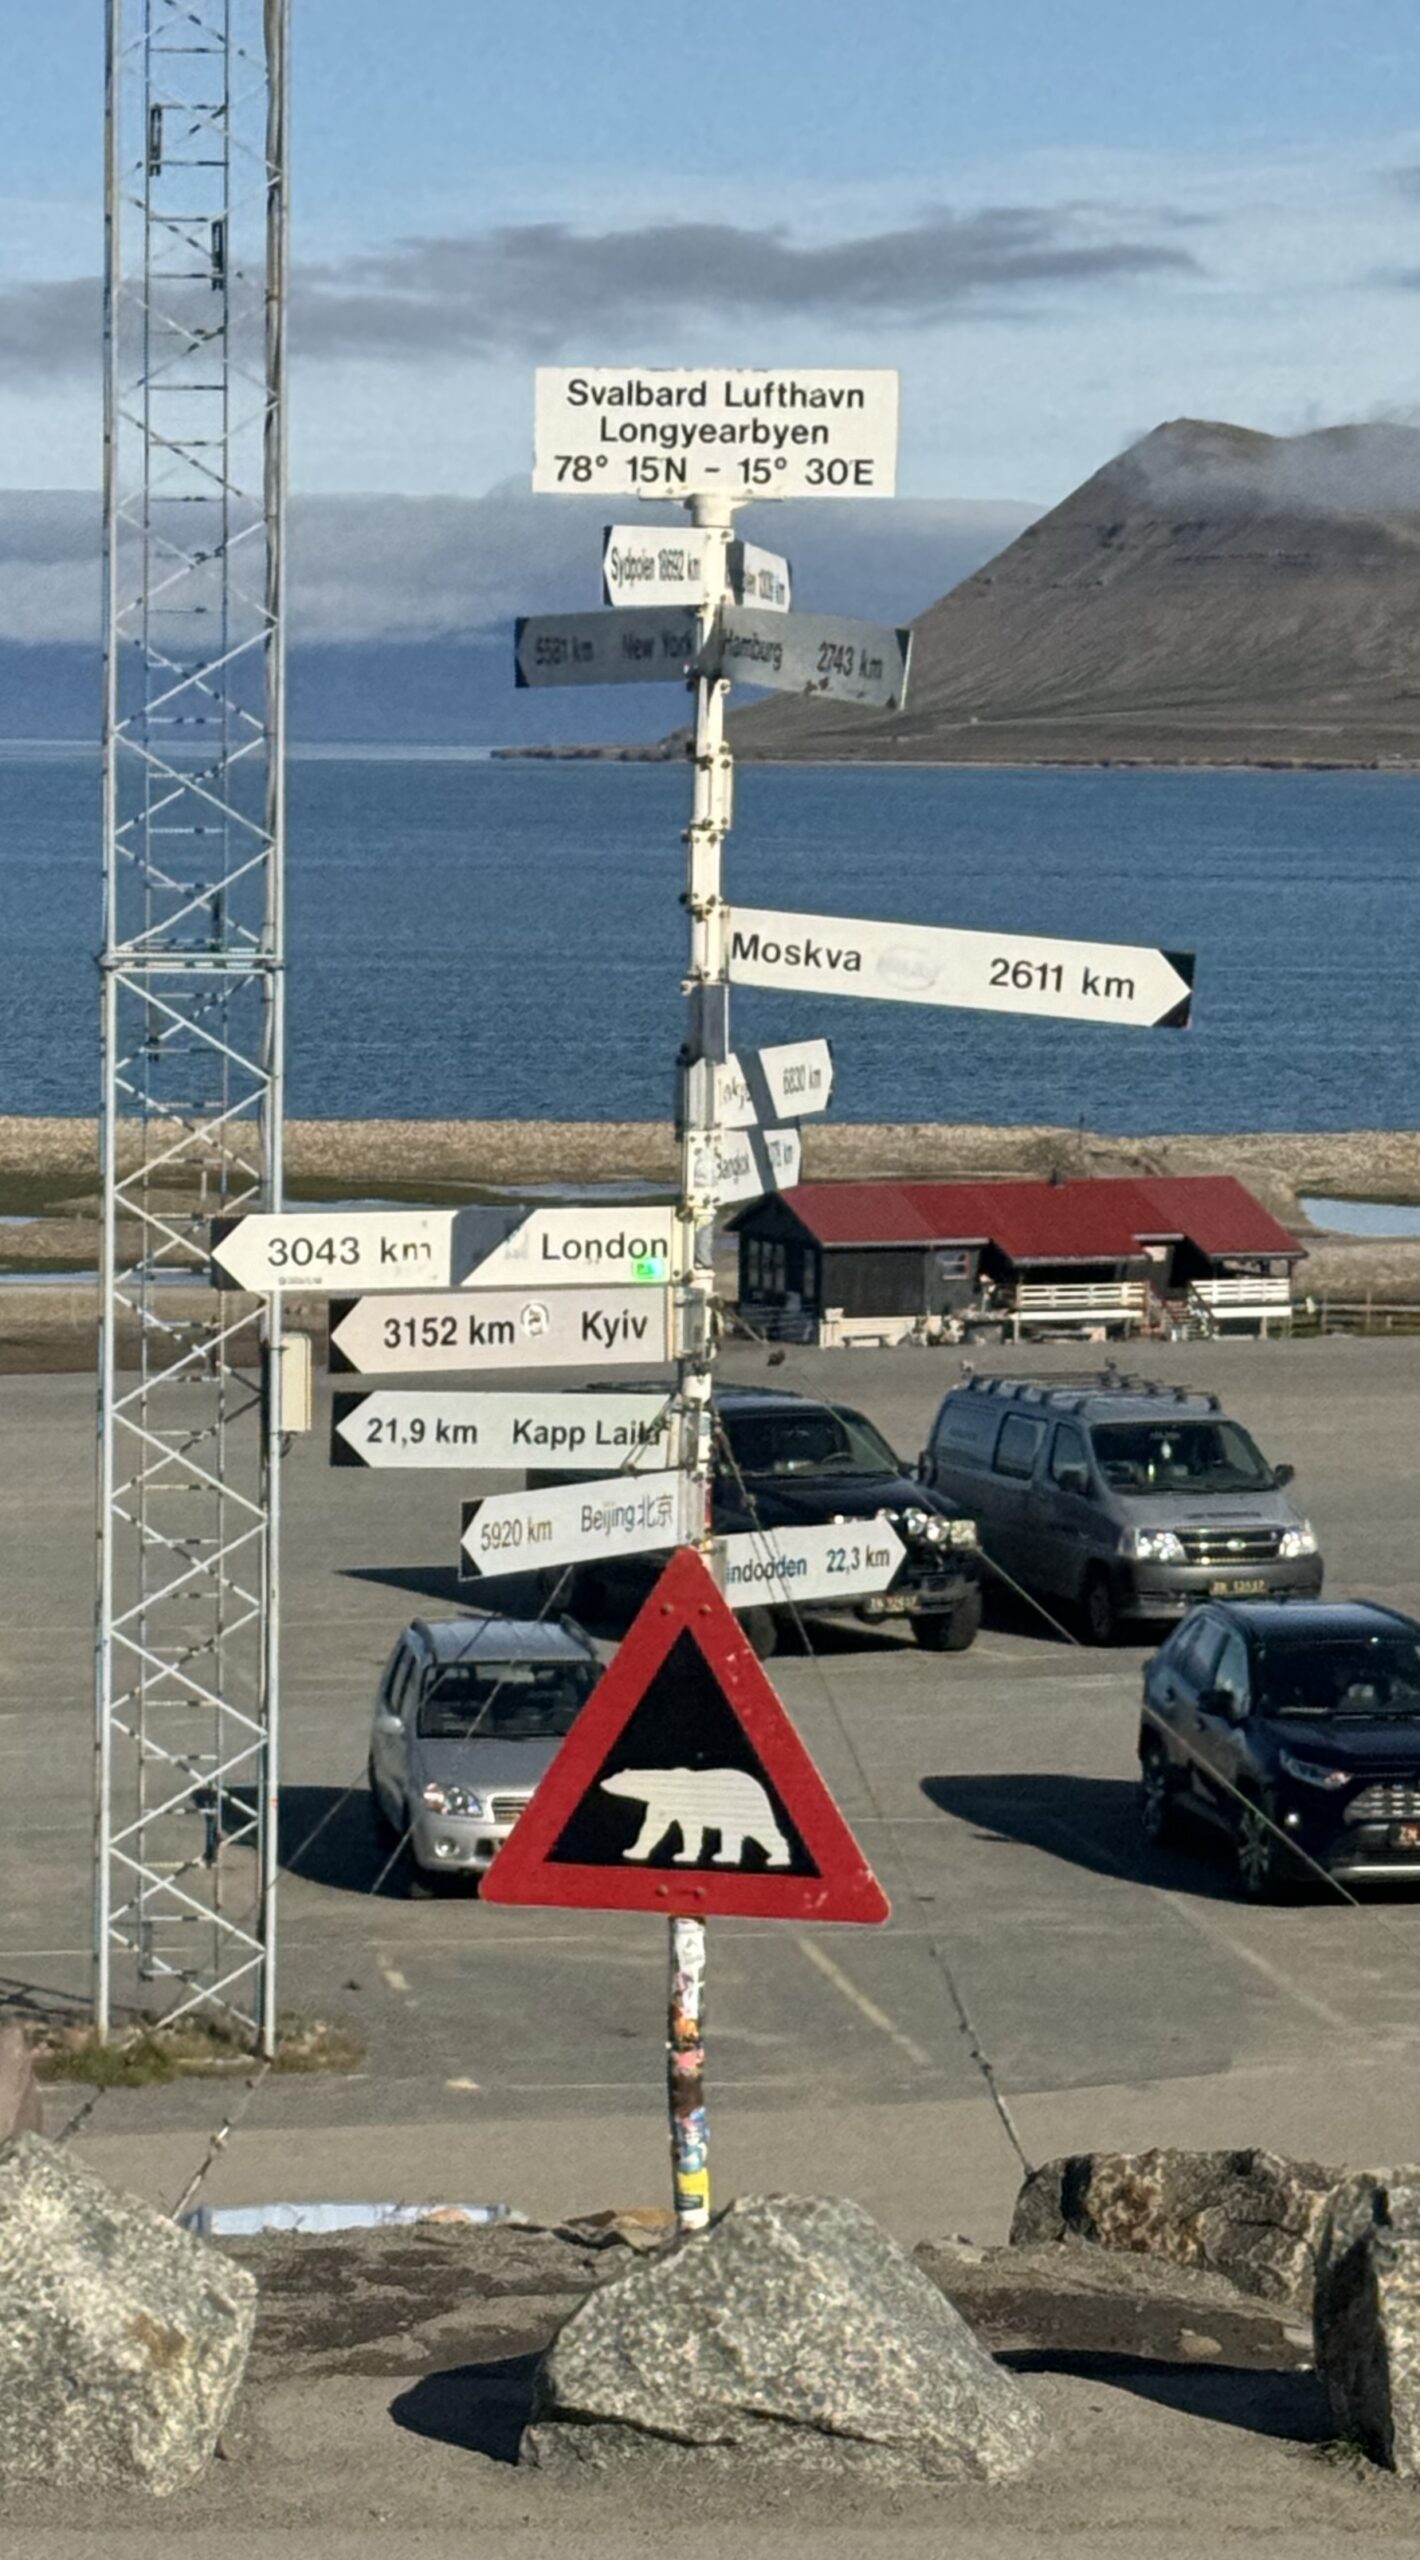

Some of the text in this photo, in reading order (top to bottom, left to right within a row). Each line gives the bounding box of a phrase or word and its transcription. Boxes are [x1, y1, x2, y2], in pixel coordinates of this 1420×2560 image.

[566, 378, 864, 408] Svalbard Lufthavn
[600, 415, 829, 450] Longyearbyen
[553, 454, 608, 483] 78°
[737, 456, 787, 485] 15°
[611, 546, 655, 588] Sydpolen
[687, 553, 701, 581] km
[572, 636, 593, 662] km
[622, 632, 655, 661] New
[661, 629, 693, 658] York
[724, 628, 883, 680] Hamburg 2743 km
[731, 931, 862, 972] Moskva
[989, 957, 1063, 993] 2611
[1081, 966, 1135, 1000] km
[809, 1064, 822, 1089] km
[267, 1236, 361, 1267] 3043
[380, 1236, 432, 1264] km
[541, 1231, 668, 1261] London
[384, 1315, 458, 1349] 3152
[469, 1314, 515, 1346] km
[581, 1308, 648, 1349] Kyiv
[366, 1417, 661, 1452] 21,9 km Kapp Laila
[480, 1518, 523, 1551] 5920
[526, 1516, 553, 1544] km
[726, 1545, 891, 1584] indodden 22,3 km
